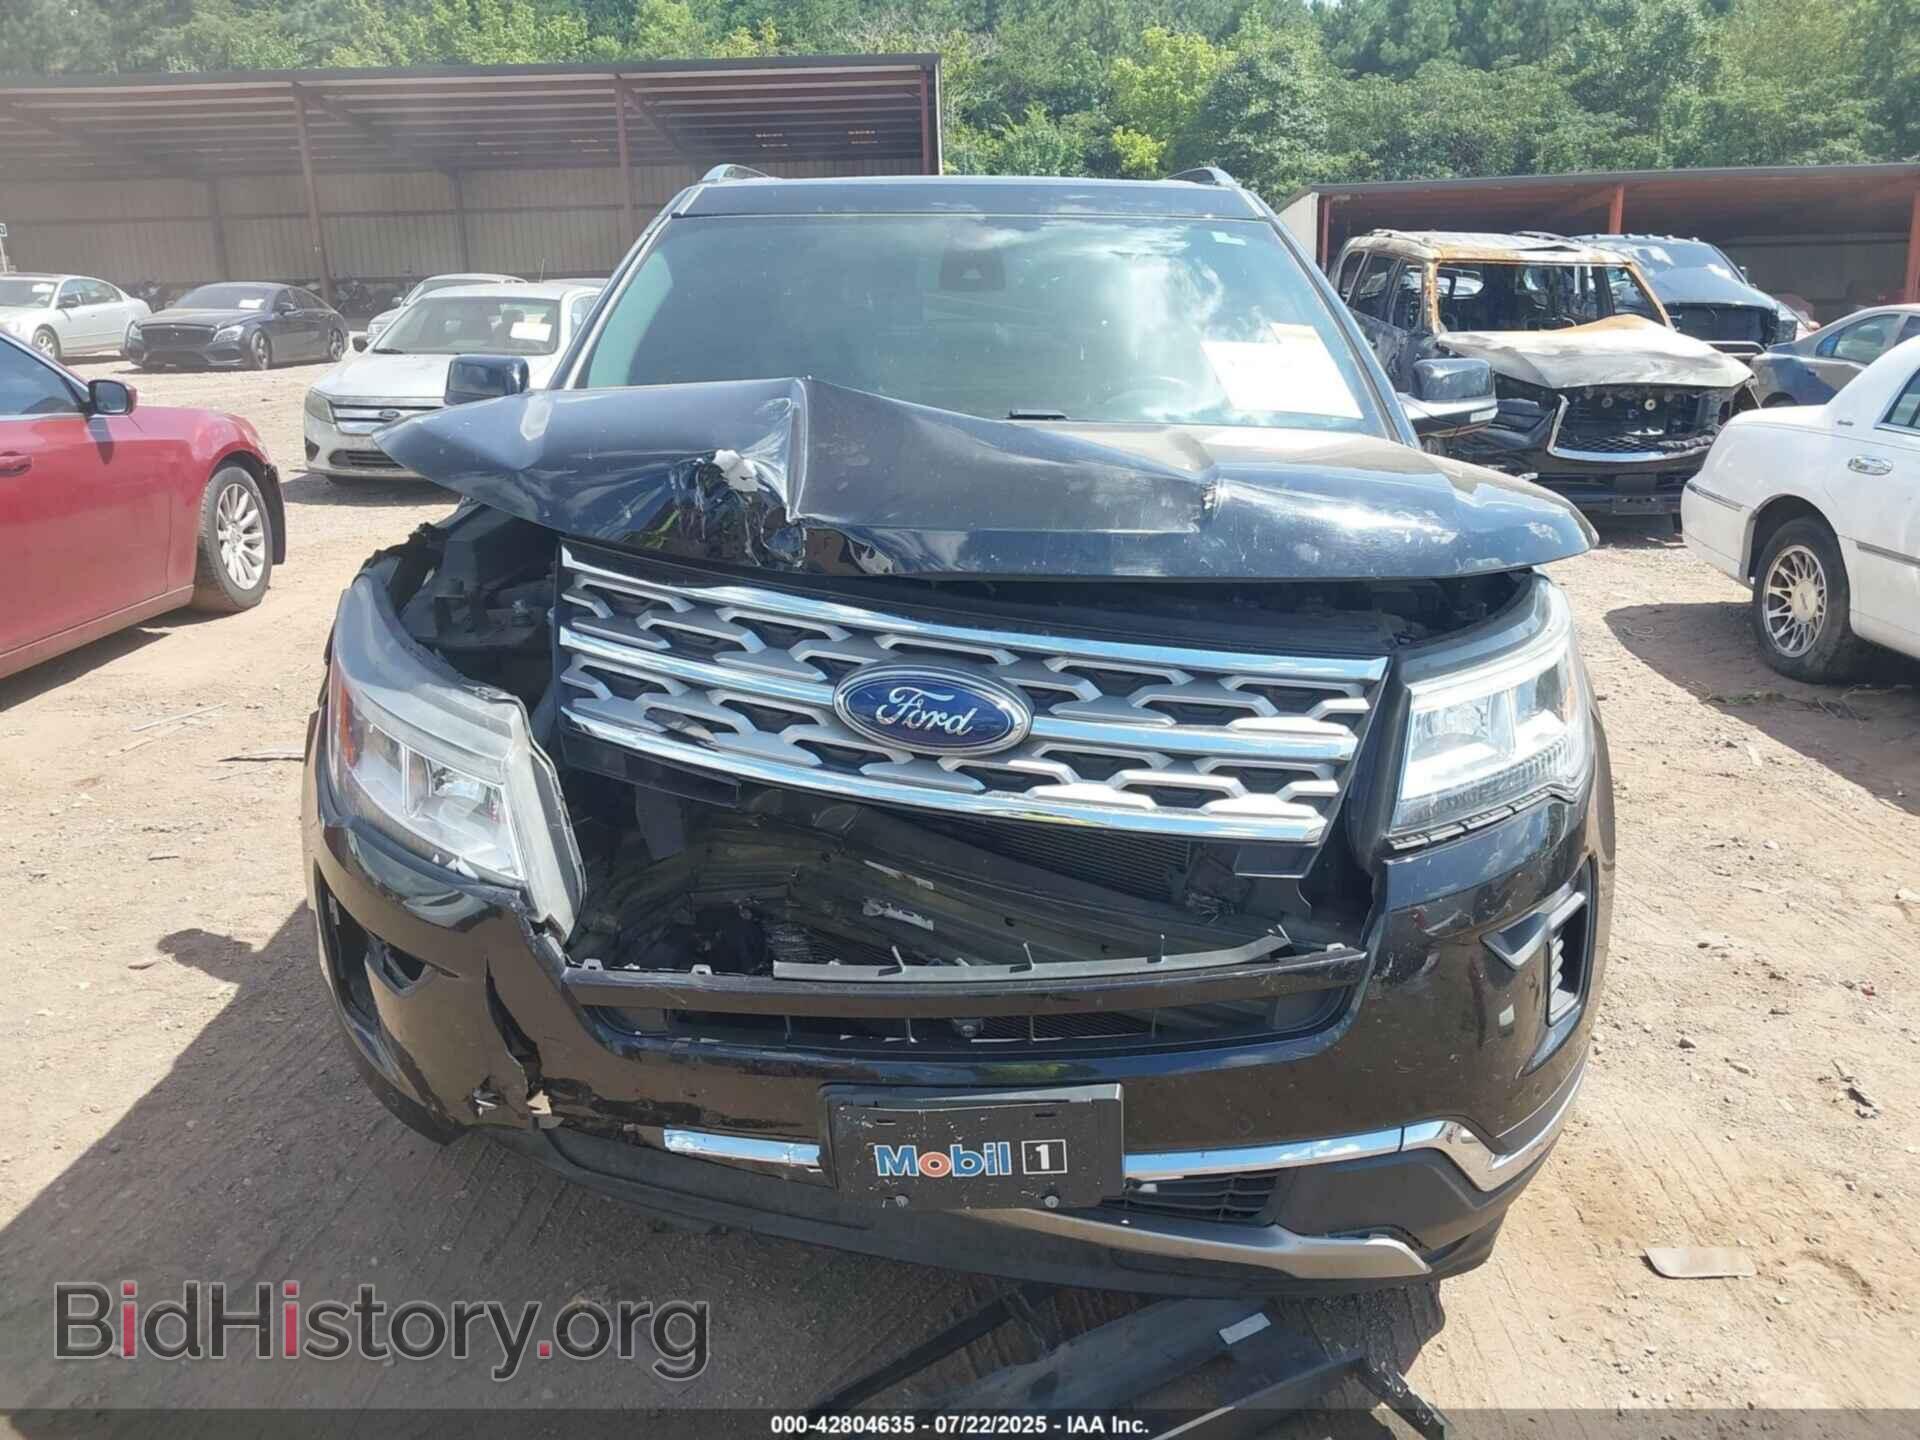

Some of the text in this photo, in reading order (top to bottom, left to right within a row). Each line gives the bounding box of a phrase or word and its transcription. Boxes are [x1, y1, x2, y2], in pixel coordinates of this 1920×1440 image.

[875, 686, 978, 736] Ford
[874, 1141, 1050, 1178] Mobil 1
